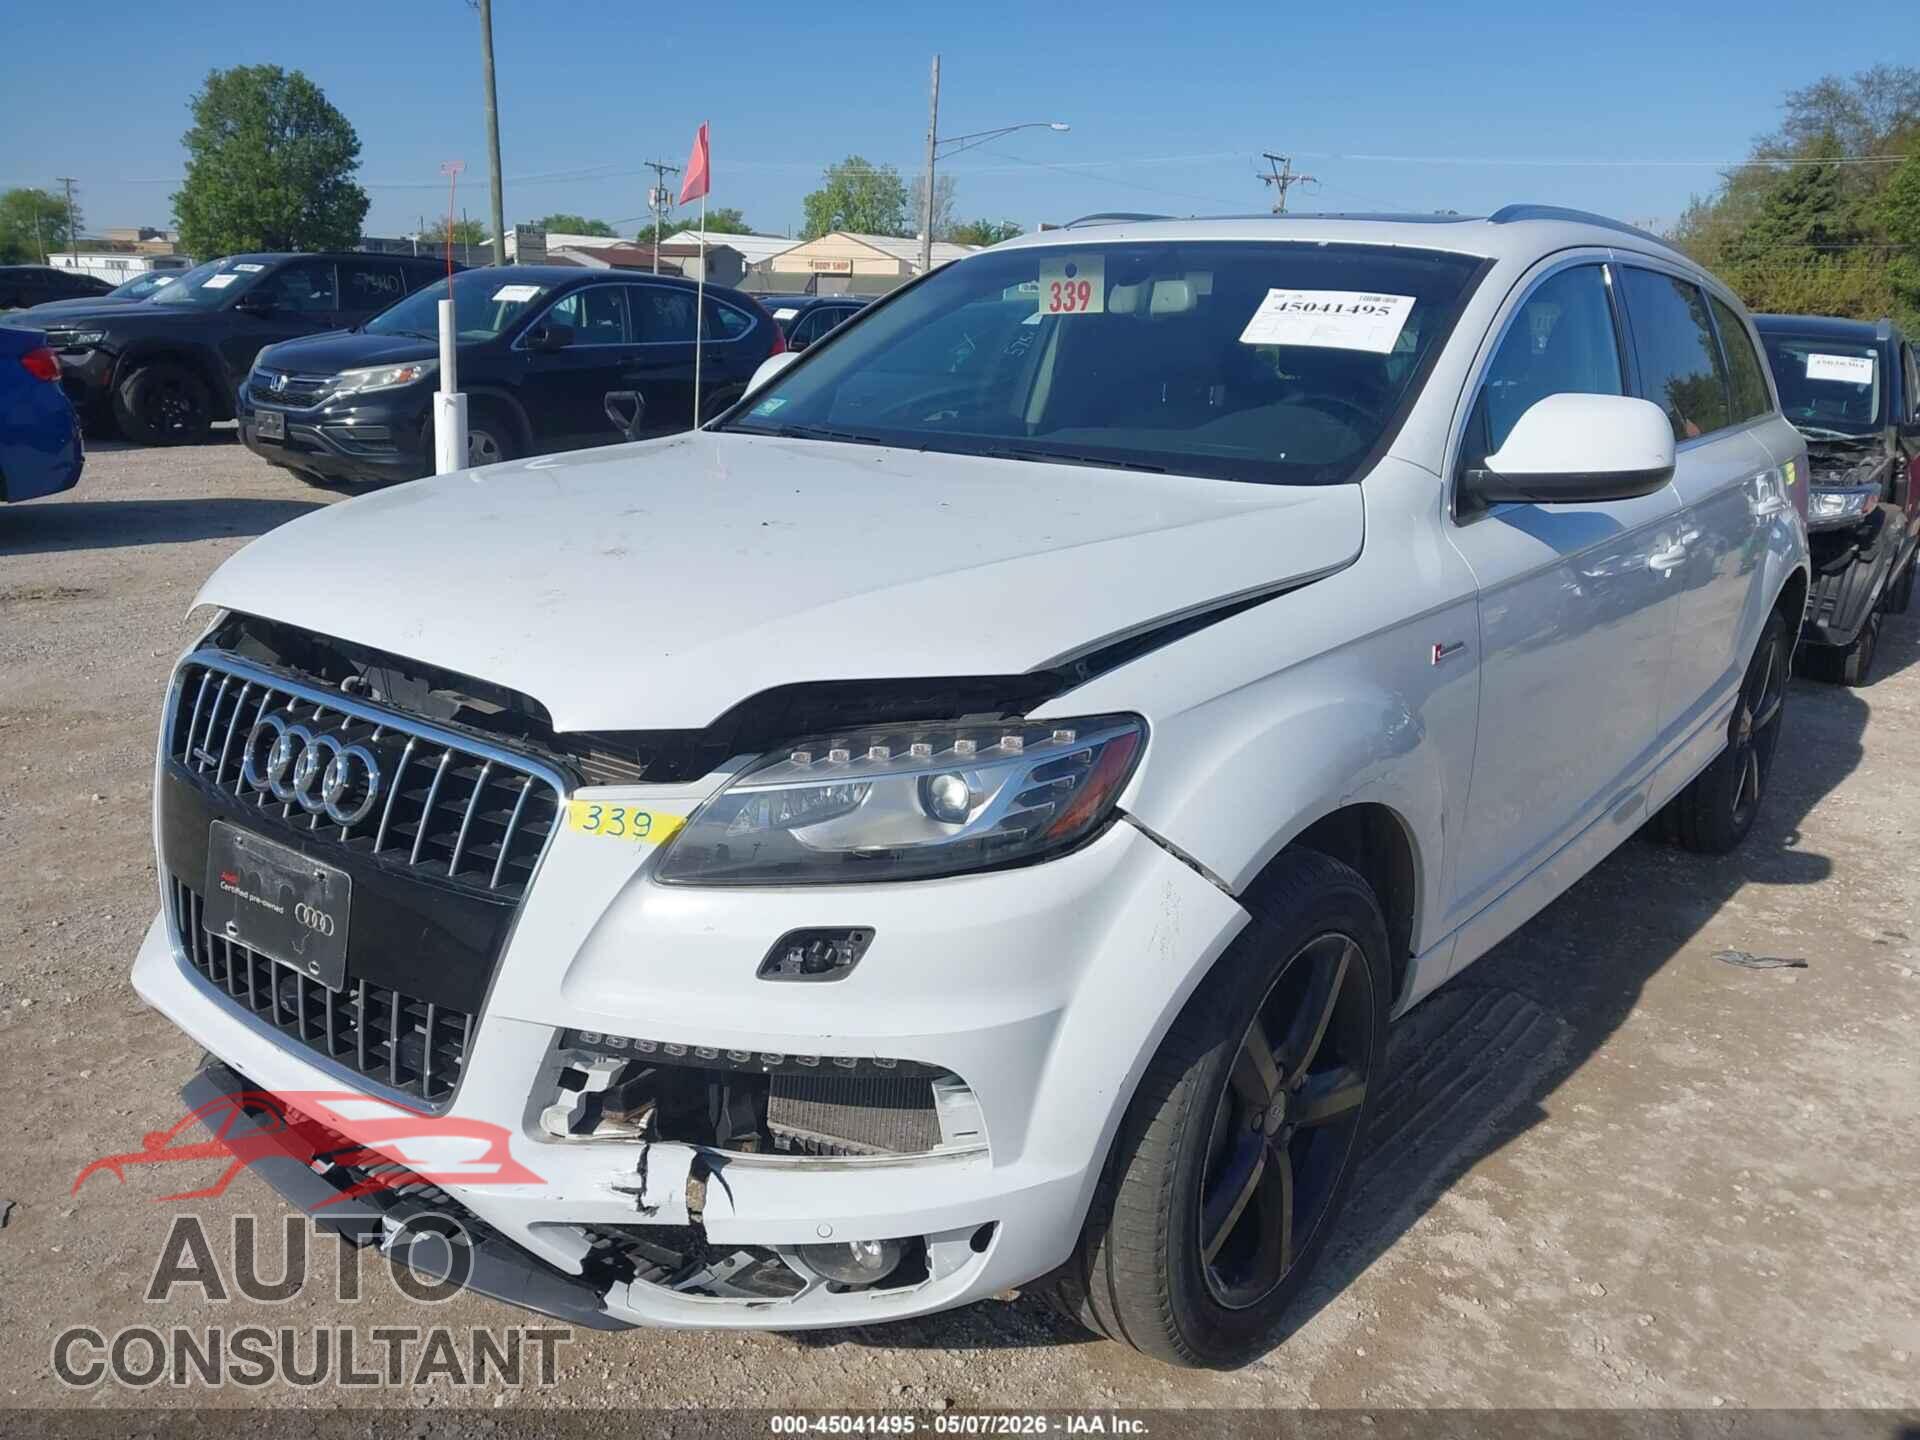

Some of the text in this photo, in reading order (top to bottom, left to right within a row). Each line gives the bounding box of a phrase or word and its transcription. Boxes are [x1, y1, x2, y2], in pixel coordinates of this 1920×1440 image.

[832, 261, 849, 270] SHOP
[1050, 280, 1092, 312] 339
[1274, 301, 1391, 317] 45041495
[582, 805, 652, 837] 339
[220, 880, 284, 915] Certified pre-owned
